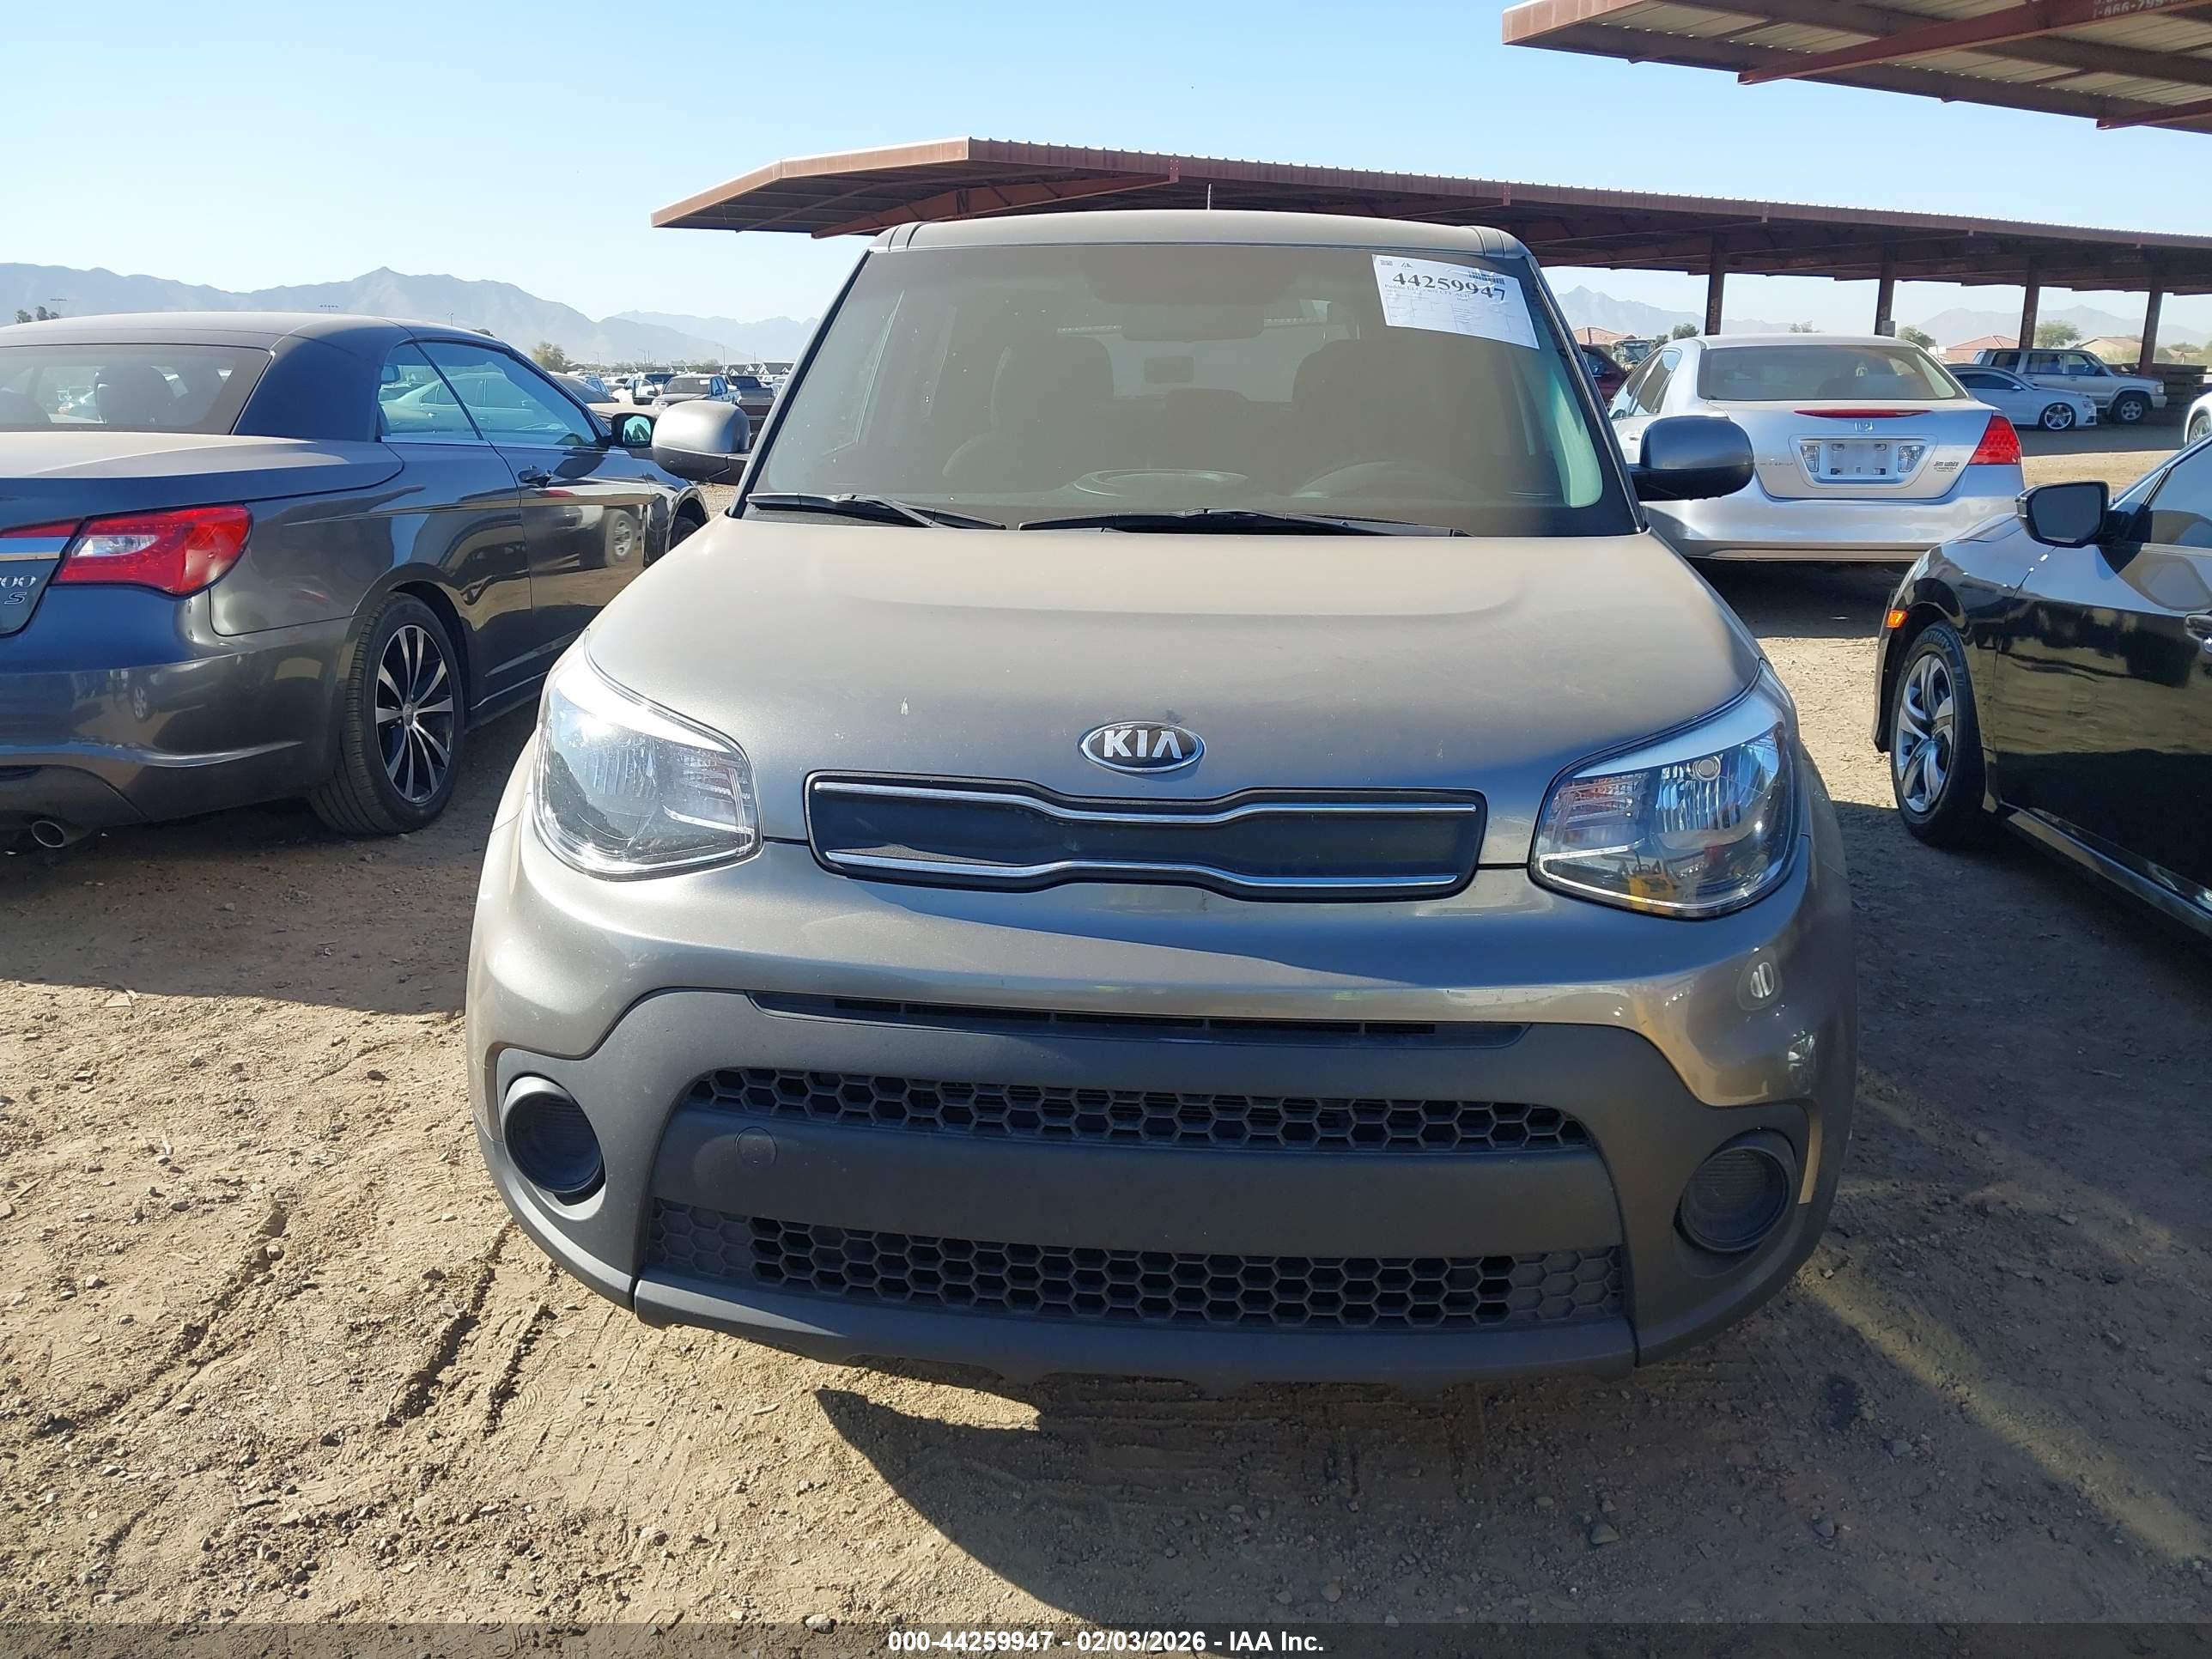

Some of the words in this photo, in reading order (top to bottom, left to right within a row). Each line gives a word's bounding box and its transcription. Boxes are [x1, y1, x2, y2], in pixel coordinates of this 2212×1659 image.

[1392, 272, 1505, 301] 44259947
[0, 574, 37, 588] 00
[3, 591, 27, 605] S
[1103, 729, 1183, 759] KIA
